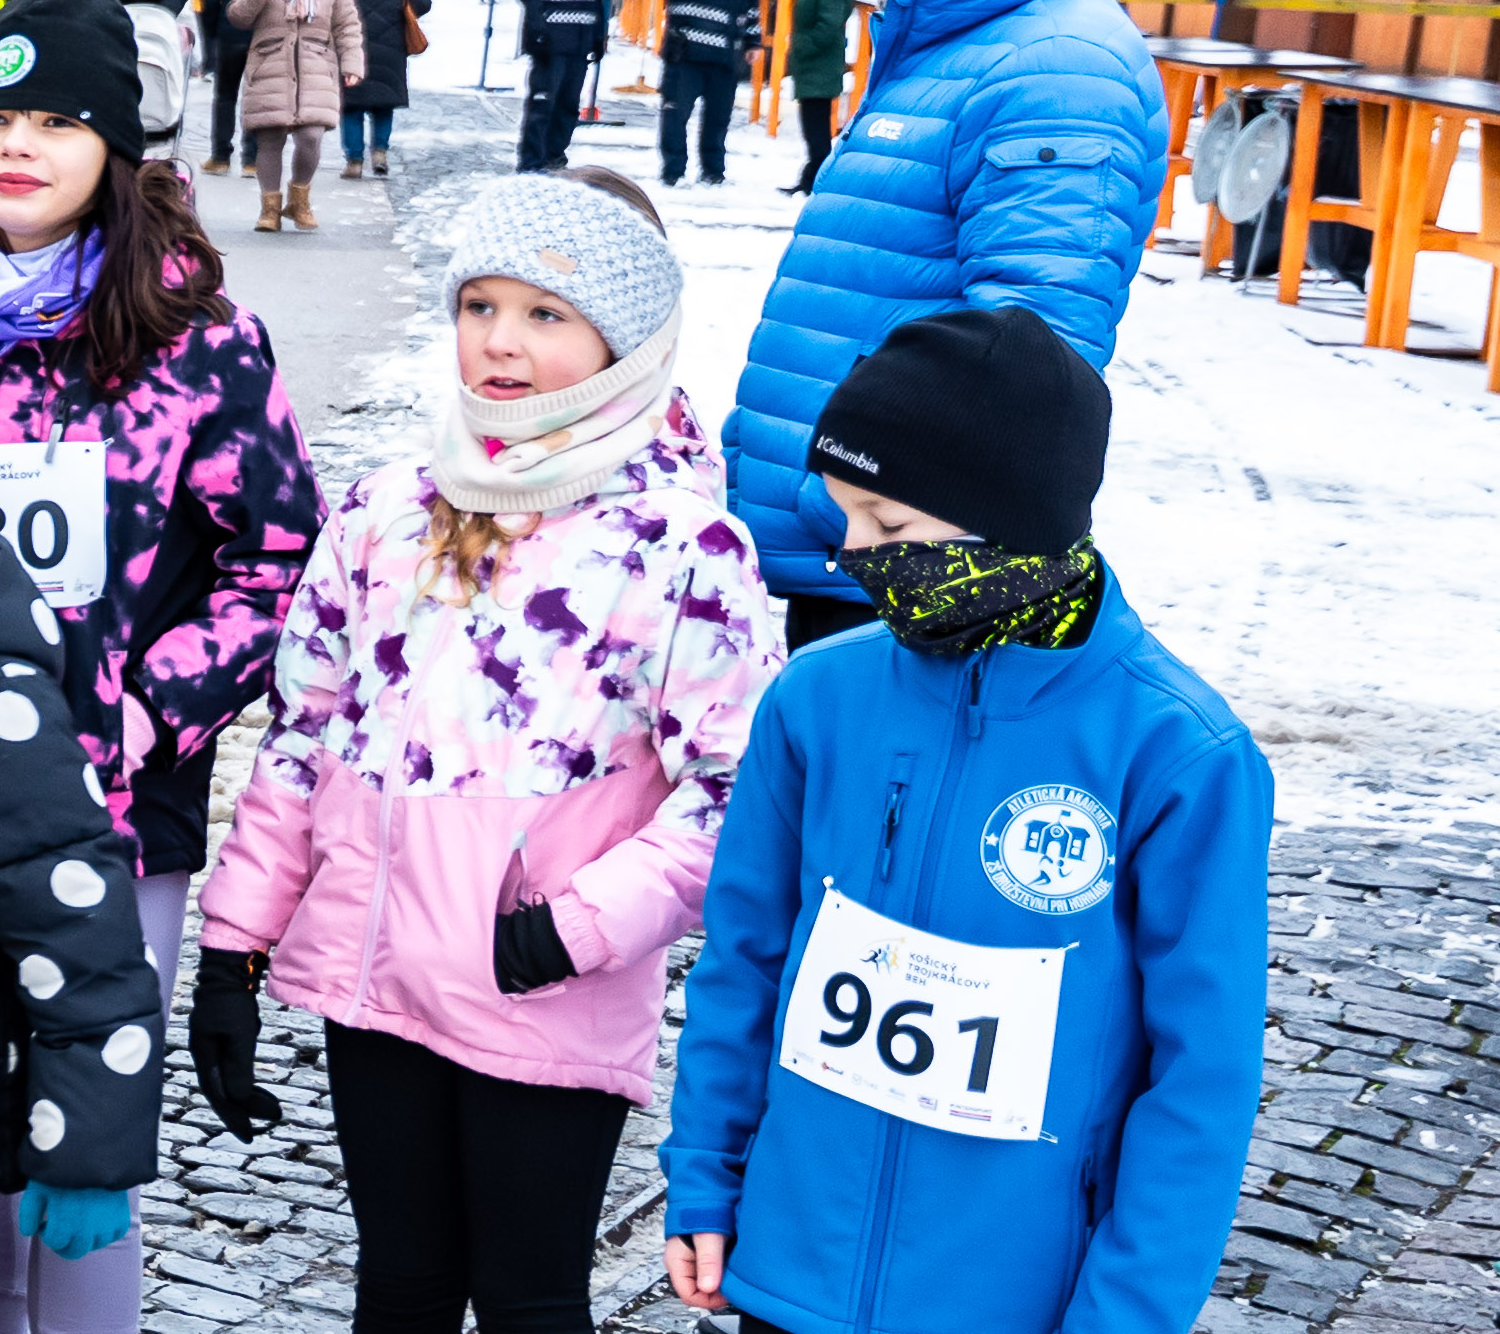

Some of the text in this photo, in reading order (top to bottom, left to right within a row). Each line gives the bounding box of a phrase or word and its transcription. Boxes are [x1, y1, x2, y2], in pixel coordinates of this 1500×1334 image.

[823, 438, 879, 474] Columbia
[1006, 786, 1066, 814] ATLETICKÁ
[1050, 899, 1069, 912] PRI
[908, 952, 957, 973] KOŠICKÝ
[905, 973, 927, 987] BEH
[819, 971, 999, 1094] 961
